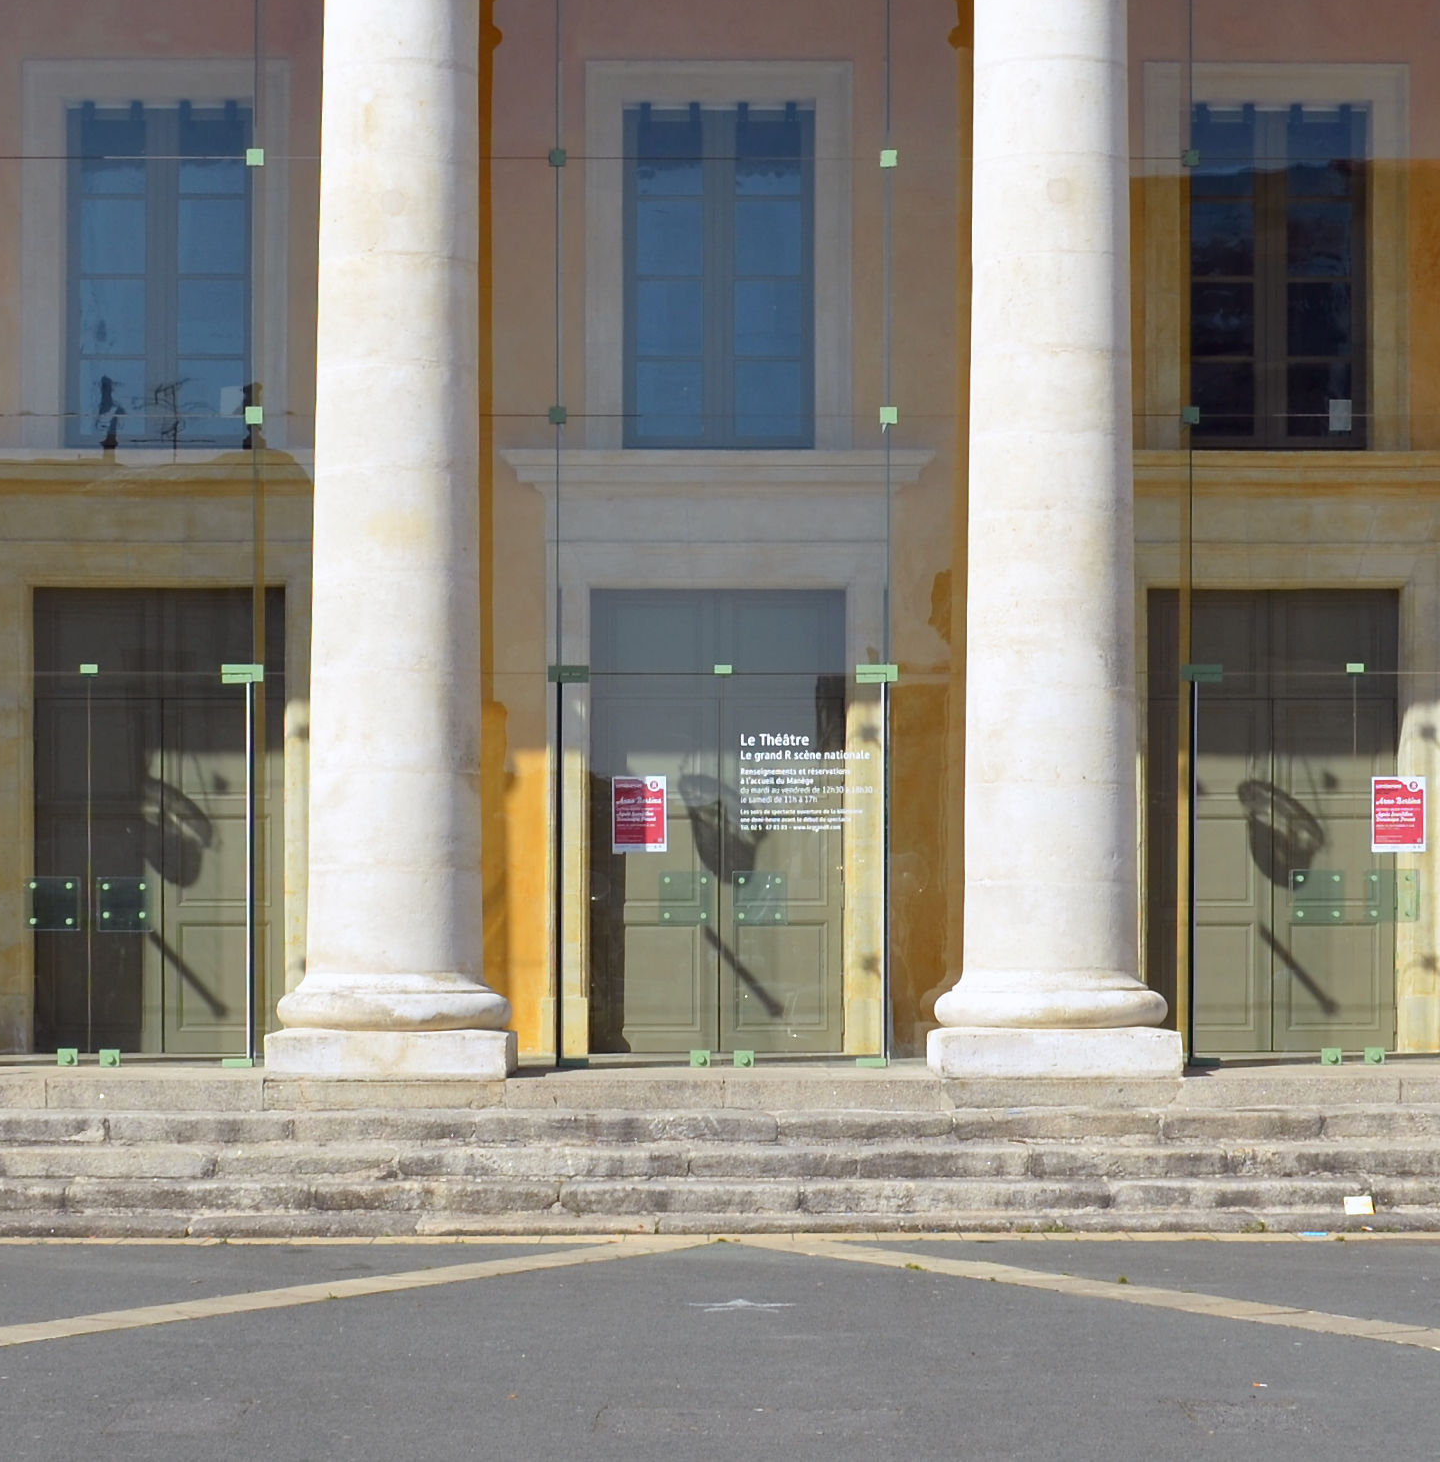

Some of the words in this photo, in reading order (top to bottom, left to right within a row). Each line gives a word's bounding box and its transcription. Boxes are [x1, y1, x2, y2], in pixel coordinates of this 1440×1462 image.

[740, 734, 756, 746] Le
[759, 733, 810, 746] Théâtre
[740, 751, 752, 760] Le
[754, 750, 782, 762] grand
[785, 751, 791, 760] R
[794, 750, 821, 760] scène
[824, 750, 870, 760] nationale
